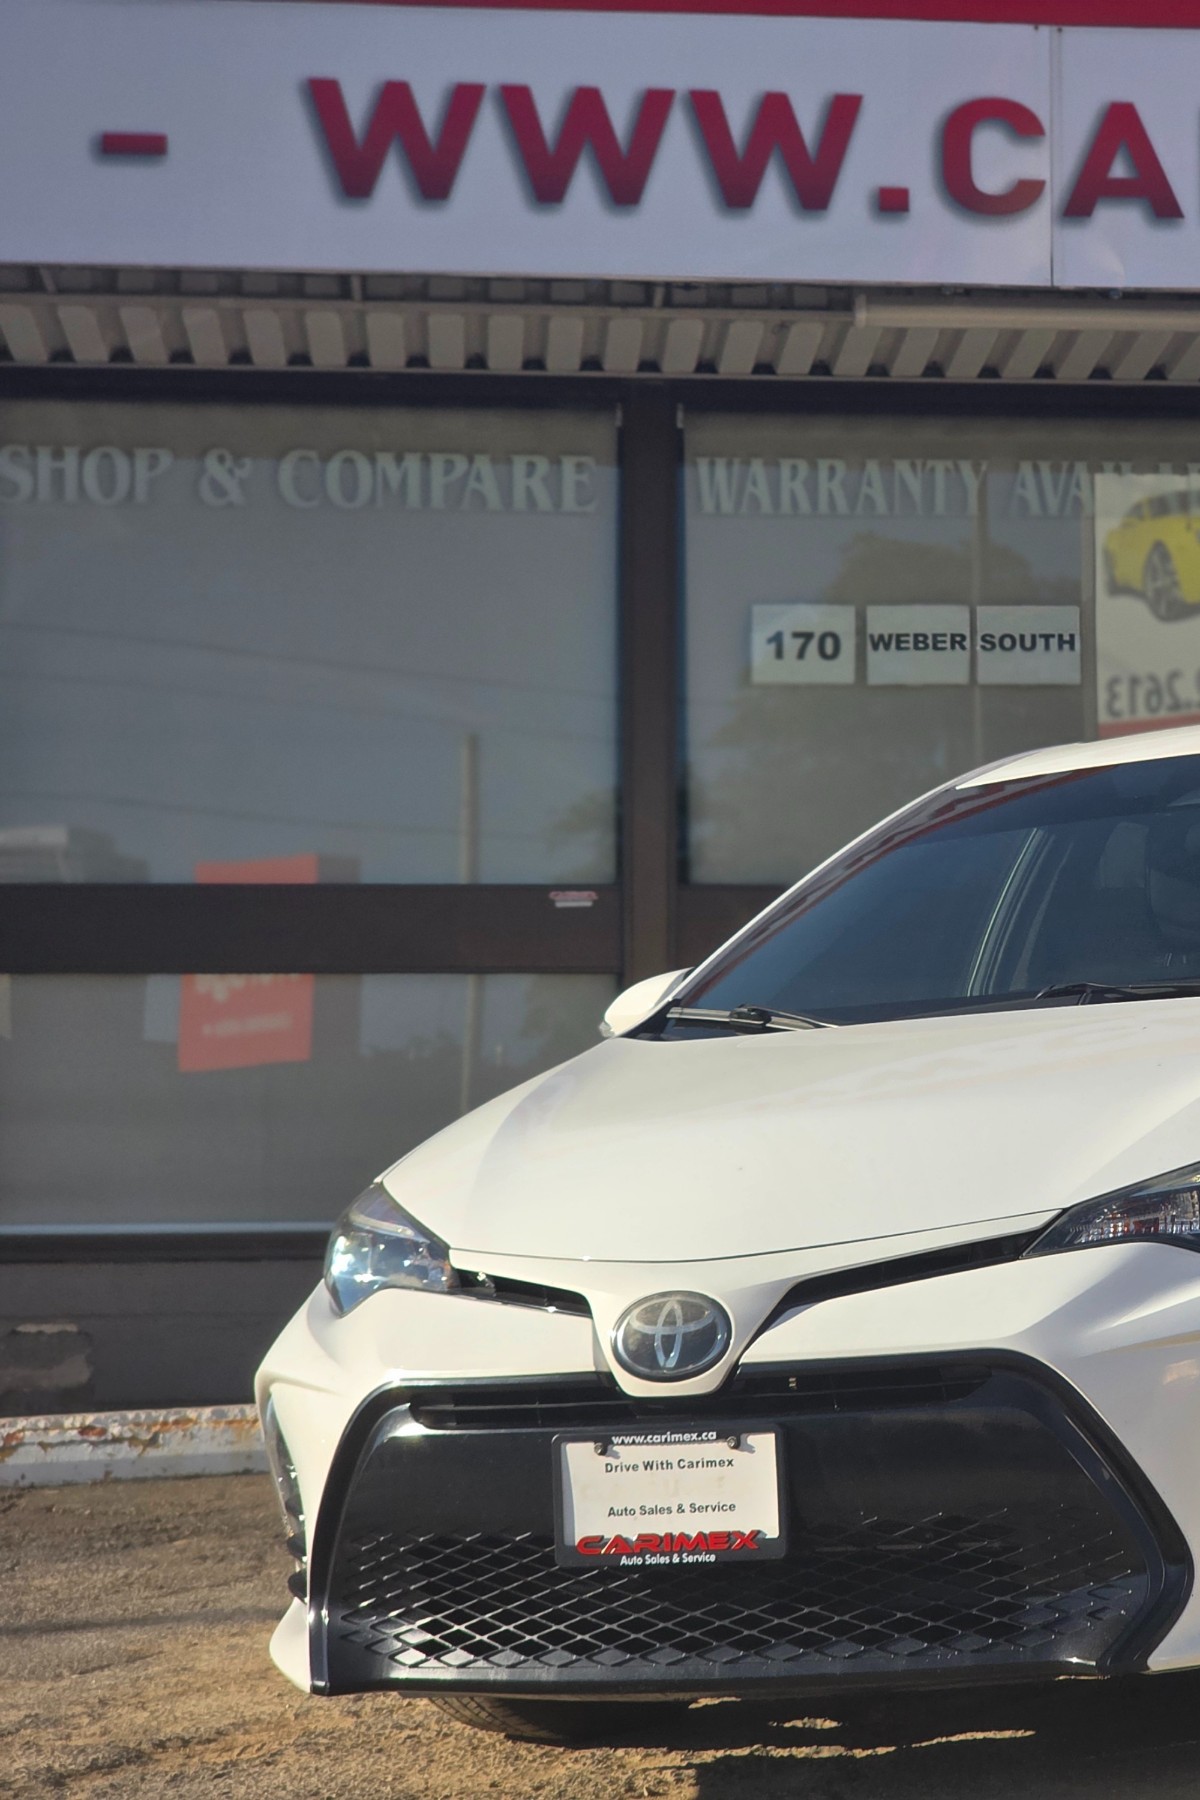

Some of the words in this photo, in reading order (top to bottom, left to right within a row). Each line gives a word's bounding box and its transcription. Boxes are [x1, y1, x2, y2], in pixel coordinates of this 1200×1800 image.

[0, 444, 174, 505] SHOP
[199, 446, 253, 507] &
[277, 448, 598, 514] COMPARE
[696, 456, 988, 516] WARRANTY
[765, 631, 841, 661] 170
[869, 632, 968, 652] WEBER
[980, 632, 1076, 652] SOUTH
[611, 1430, 717, 1445] www.carimex.ca
[604, 1461, 639, 1473] Drive
[643, 1459, 673, 1471] With
[677, 1456, 734, 1469] Carimex
[607, 1505, 636, 1517] Auto
[639, 1503, 672, 1515] Sales
[676, 1503, 685, 1513] &
[689, 1501, 736, 1513] Service
[576, 1529, 761, 1555] CARIMEX
[620, 1554, 643, 1566] Auto
[644, 1553, 670, 1565] Sales
[672, 1553, 680, 1564] &
[682, 1552, 716, 1563] Service
